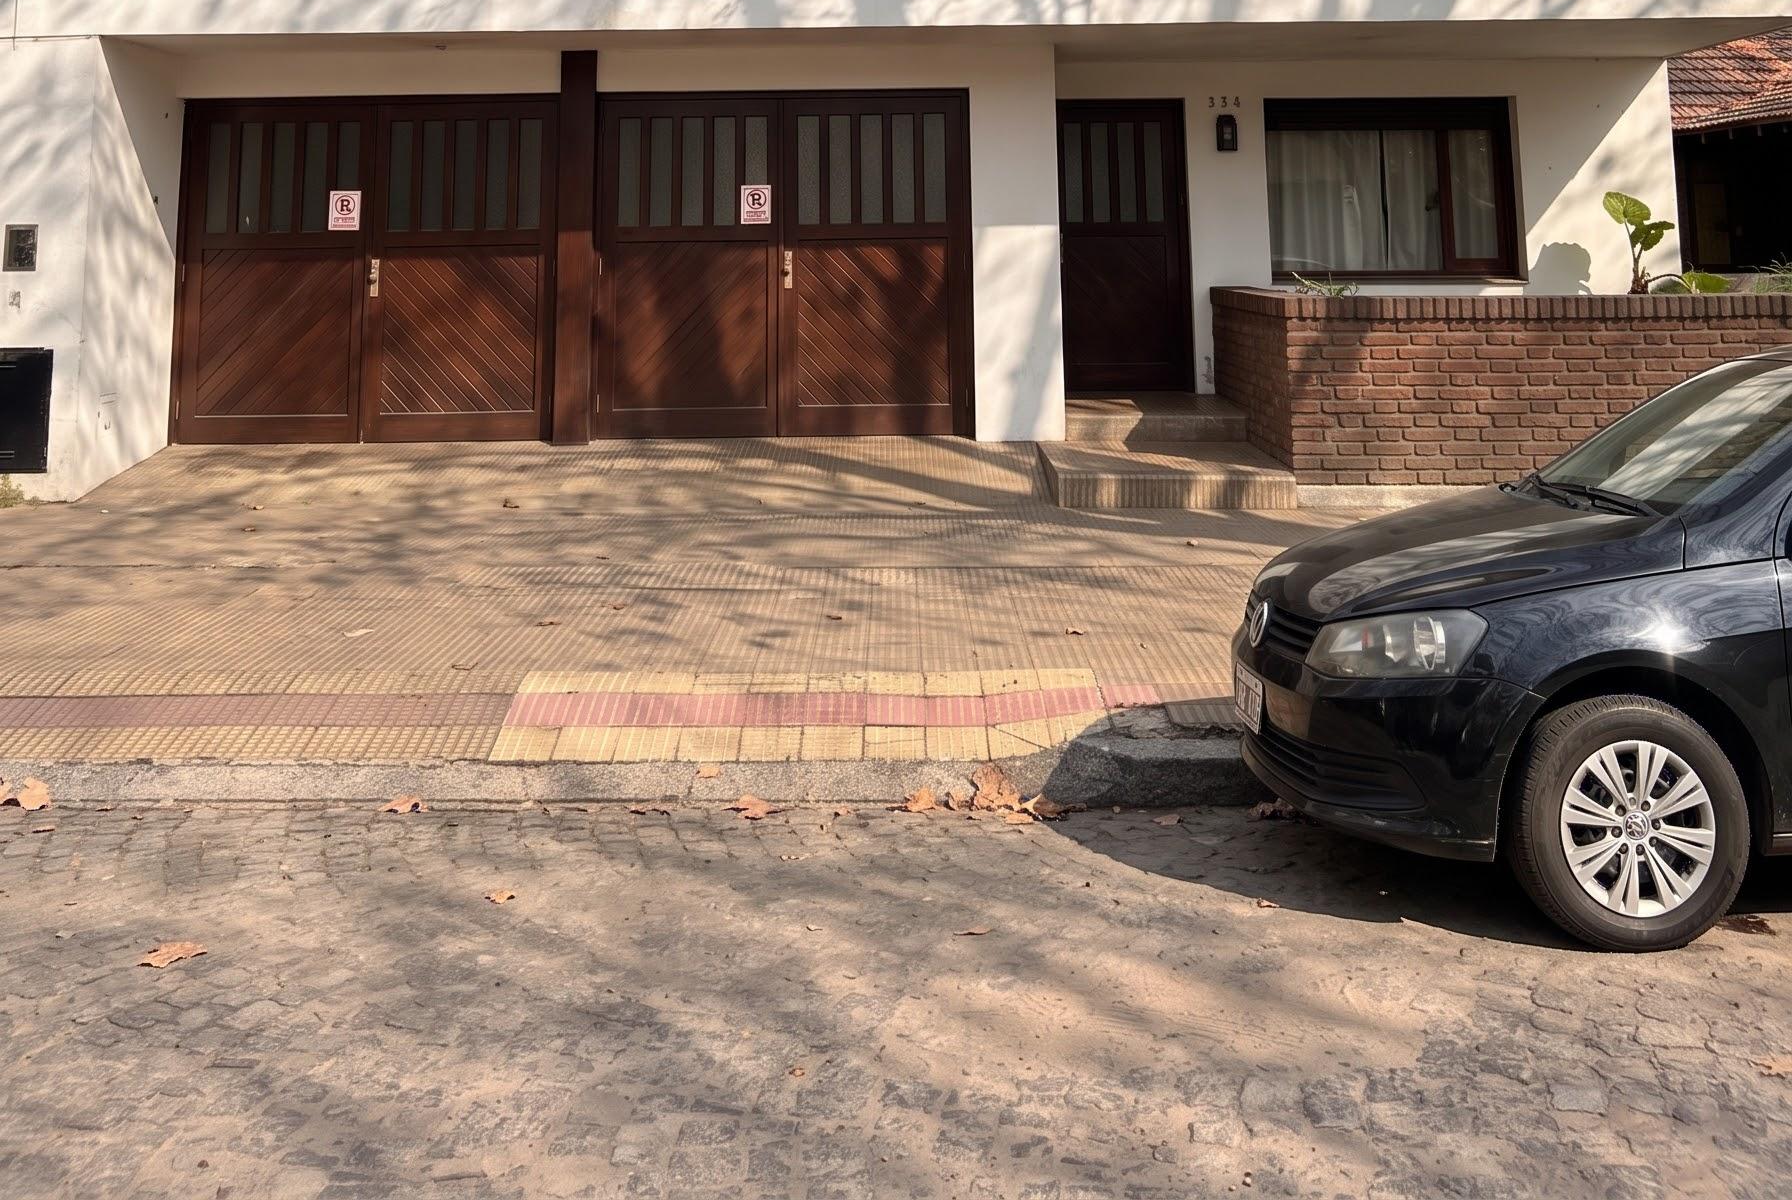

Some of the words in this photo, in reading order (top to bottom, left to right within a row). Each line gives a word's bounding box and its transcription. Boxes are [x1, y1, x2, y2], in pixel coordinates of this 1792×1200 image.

[1208, 96, 1240, 108] 334
[340, 198, 351, 212] R
[750, 193, 762, 206] R
